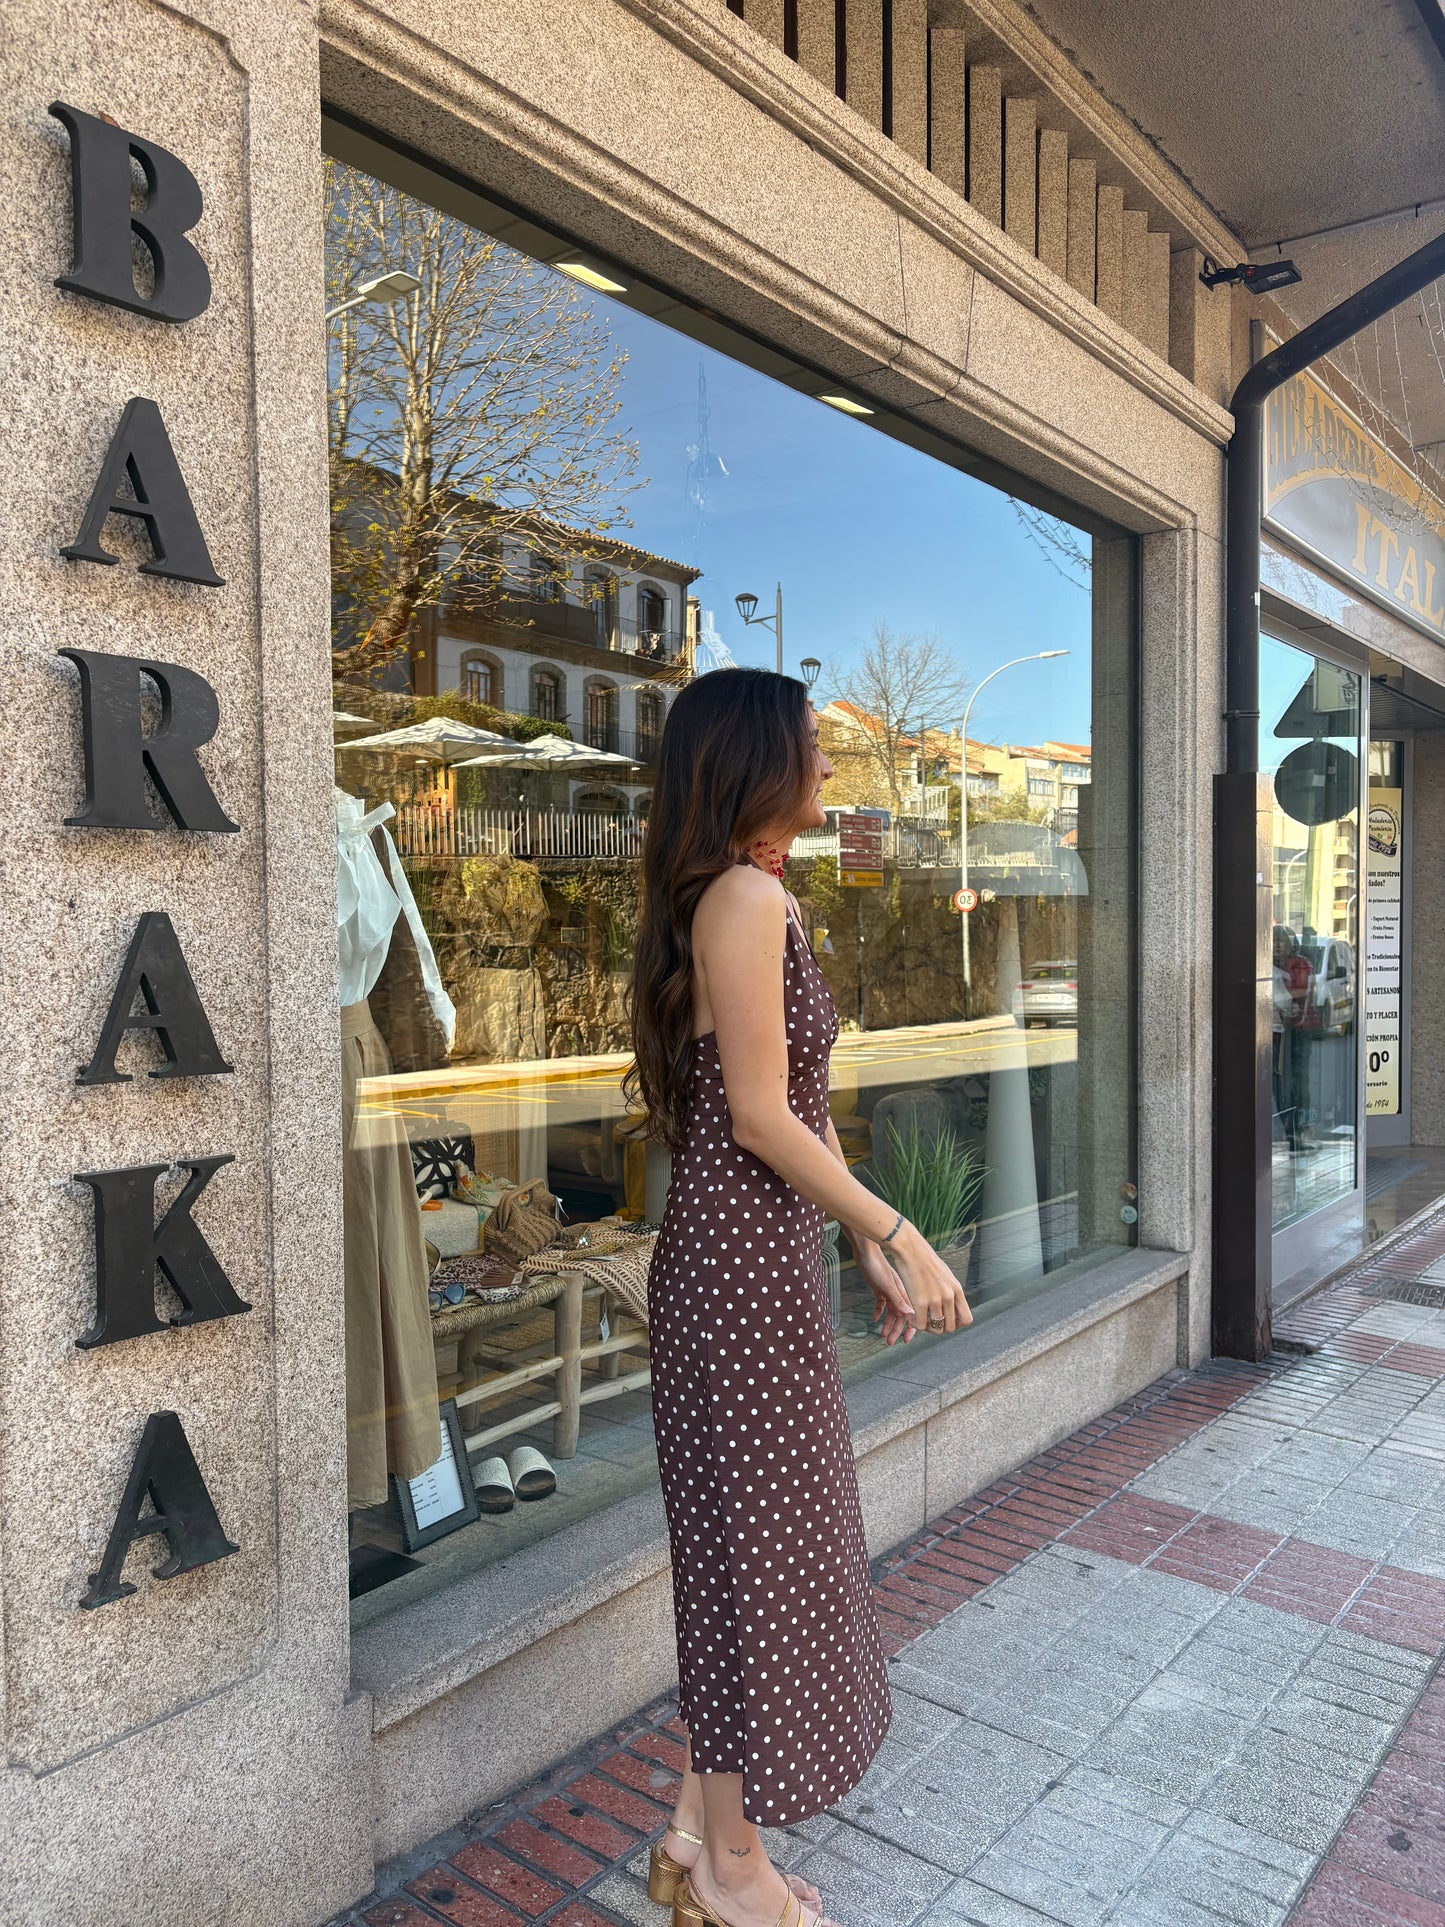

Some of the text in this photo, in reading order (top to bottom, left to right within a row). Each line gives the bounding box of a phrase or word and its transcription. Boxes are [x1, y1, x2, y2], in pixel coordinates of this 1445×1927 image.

[1268, 375, 1379, 492] HELADERIA
[1352, 502, 1445, 629] ITAL
[49, 101, 252, 1609] BARAKA
[1371, 986, 1400, 995] ARTESANOS
[1378, 1011, 1398, 1019] PLACER
[1379, 1034, 1398, 1042] PROPIA
[1368, 1050, 1390, 1073] 0º
[1374, 1099, 1389, 1109] 1984
